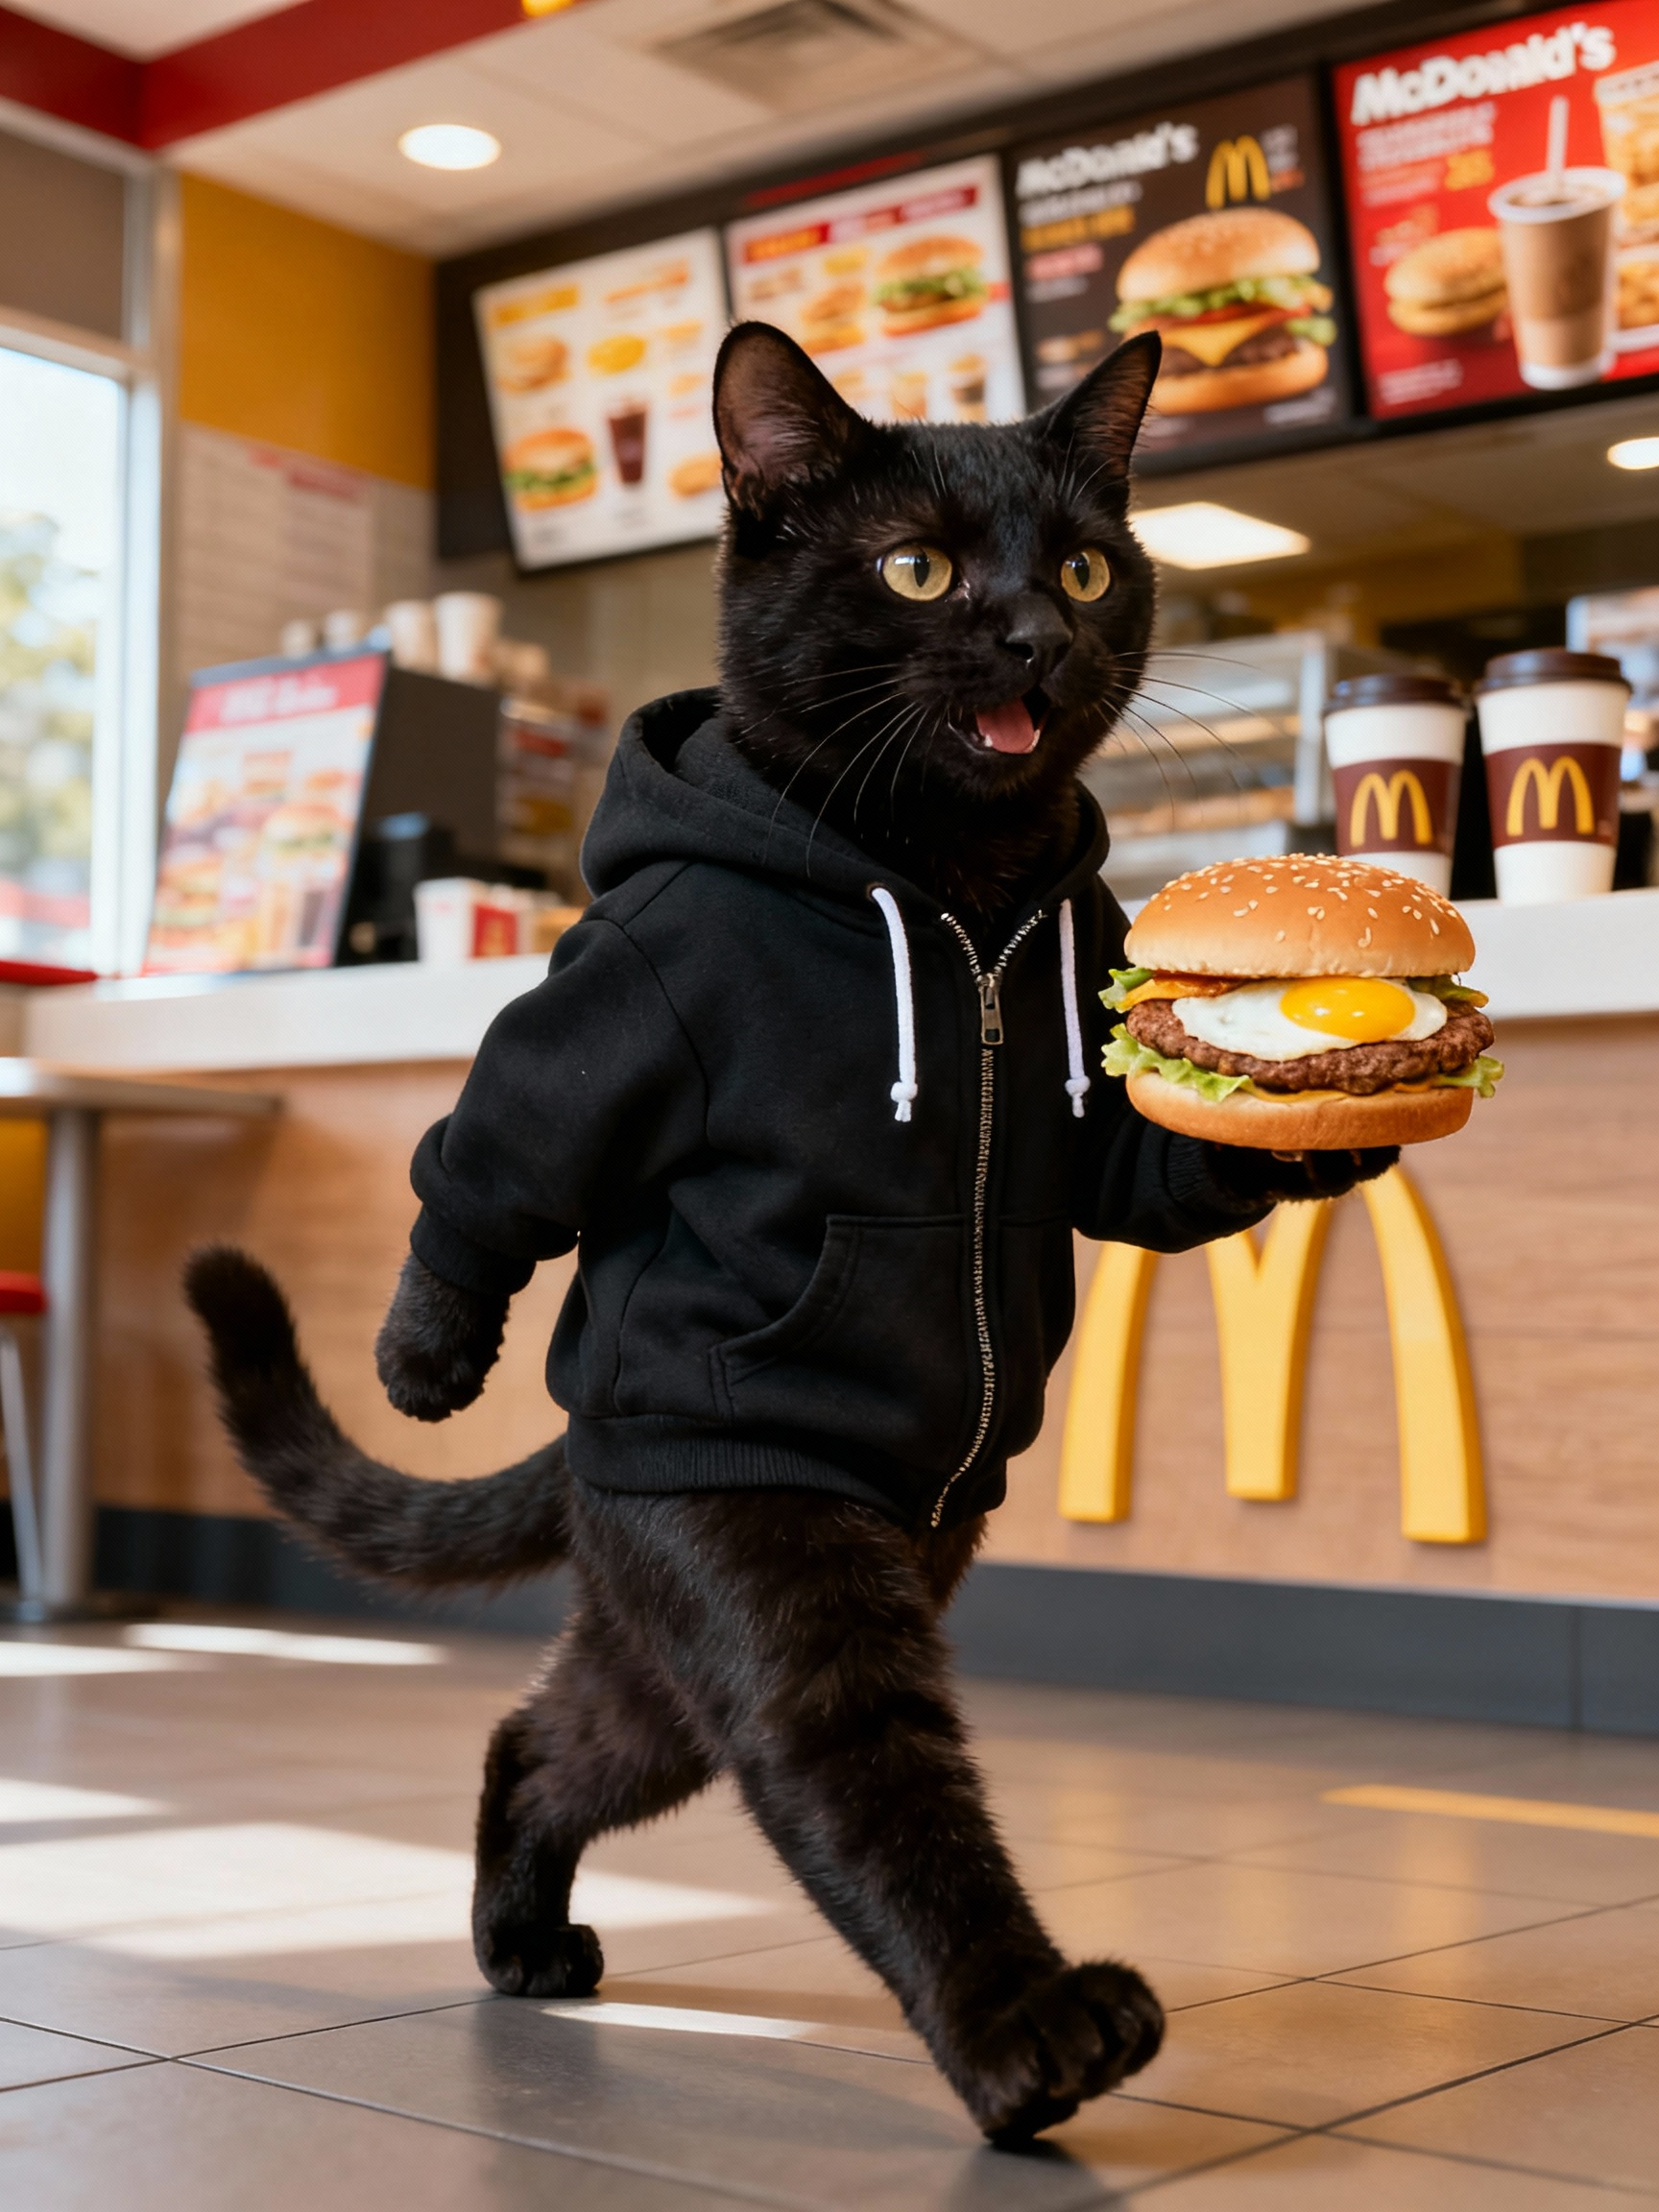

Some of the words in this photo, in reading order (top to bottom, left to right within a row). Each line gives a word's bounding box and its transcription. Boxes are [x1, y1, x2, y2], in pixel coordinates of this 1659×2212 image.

[1352, 22, 1617, 126] McDonald's
[1350, 770, 1432, 847] M
[1505, 756, 1595, 837] M
